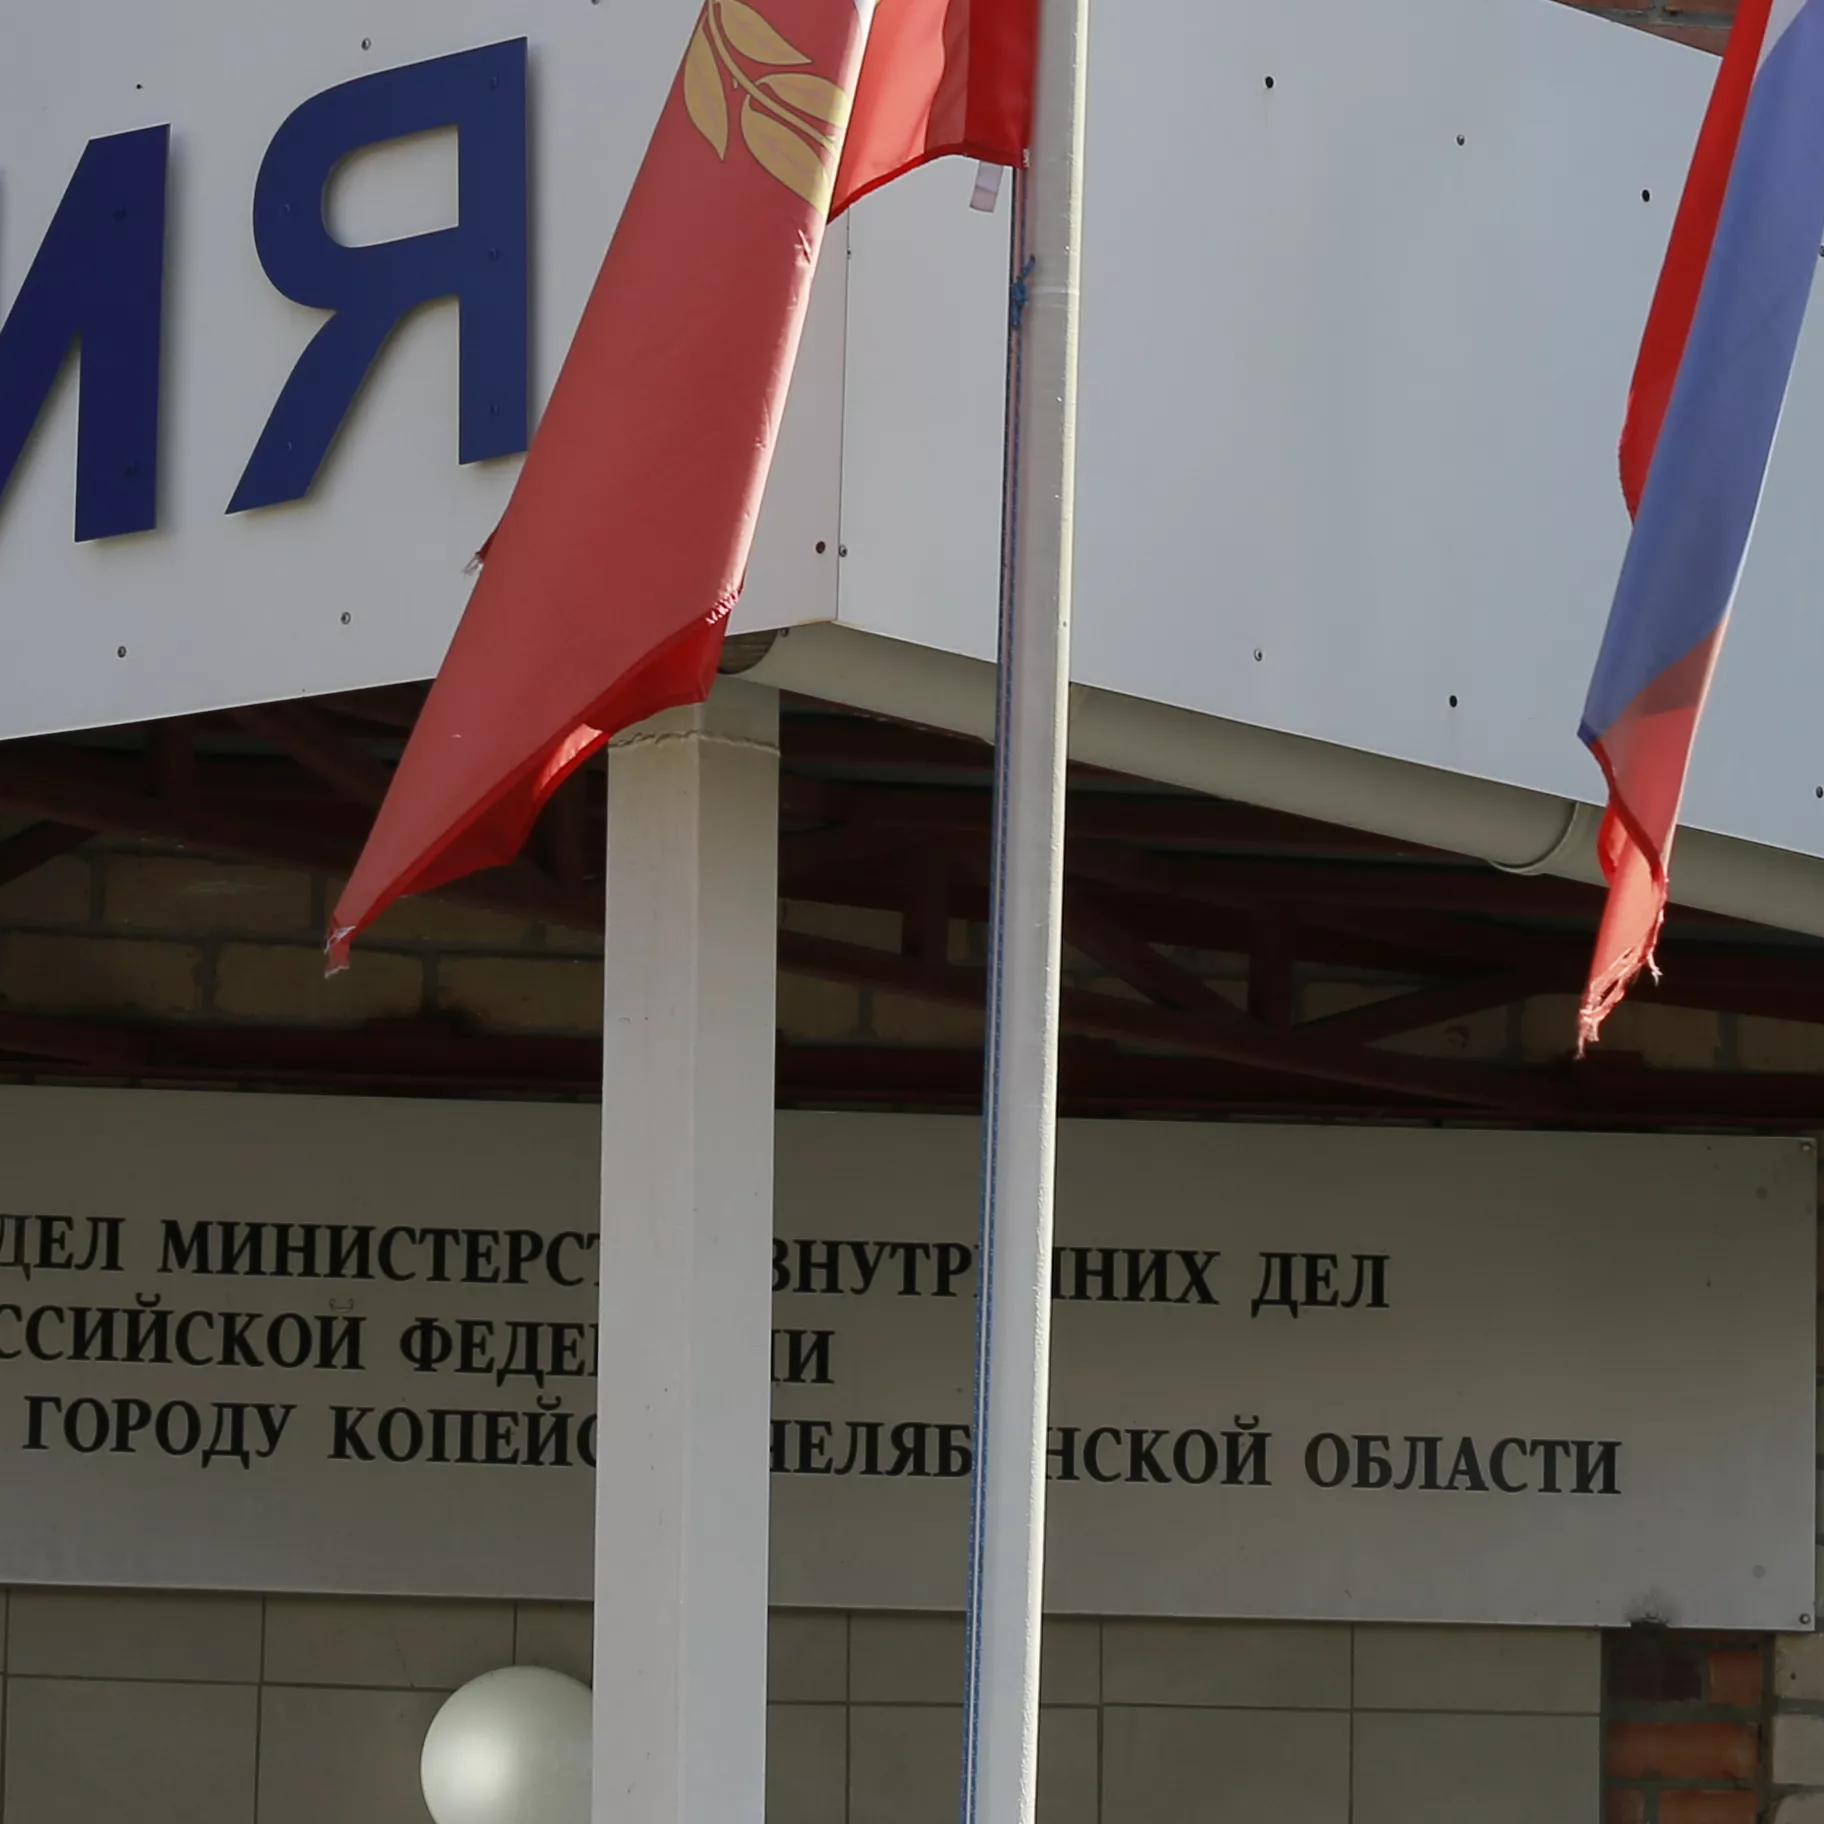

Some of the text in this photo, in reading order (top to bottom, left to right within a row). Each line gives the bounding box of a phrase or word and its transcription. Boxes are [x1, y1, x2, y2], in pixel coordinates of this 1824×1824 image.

[156, 1219, 601, 1287] МИНИСТЕРС
[770, 1236, 1221, 1305] НУТРНИХ
[1250, 1251, 1391, 1320] ДЕЛ
[399, 1316, 836, 1390] ФЕДЕИ
[21, 1395, 298, 1471] ГОРОДУ
[326, 1394, 598, 1469] КОПЕЙС
[769, 1414, 1273, 1486] ЕЛЯБНСКОЙ
[1304, 1432, 1623, 1495] ОБЛАСТИ
